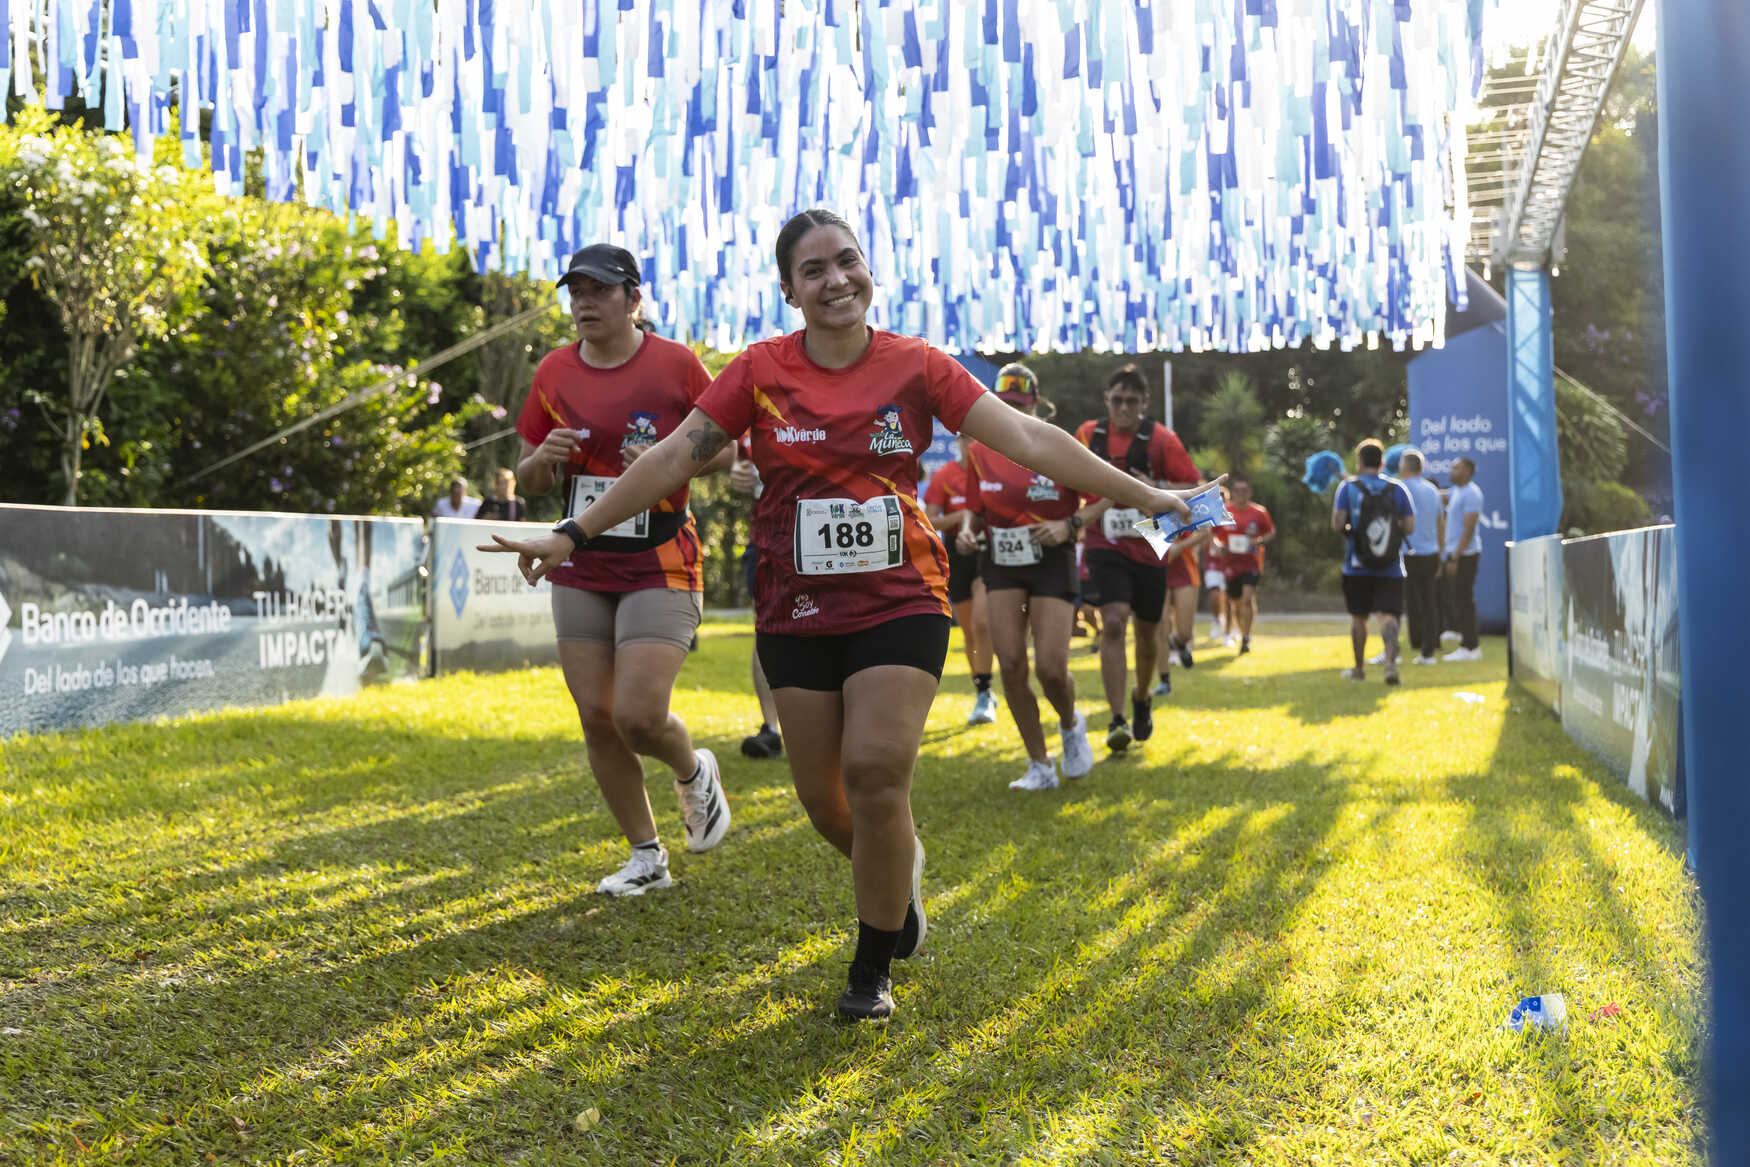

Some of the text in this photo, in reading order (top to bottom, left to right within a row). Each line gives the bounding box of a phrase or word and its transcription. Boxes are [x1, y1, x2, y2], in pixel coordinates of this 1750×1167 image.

[1420, 414, 1492, 436] Del lado
[1443, 435, 1471, 452] los
[1475, 438, 1507, 455] que
[818, 521, 874, 549] 188
[21, 597, 232, 644] Banco de Occidente
[253, 591, 280, 623] TU
[24, 666, 51, 694] Del
[55, 663, 92, 693] lado
[93, 660, 115, 688] de
[116, 658, 138, 686] los
[140, 661, 168, 689] que
